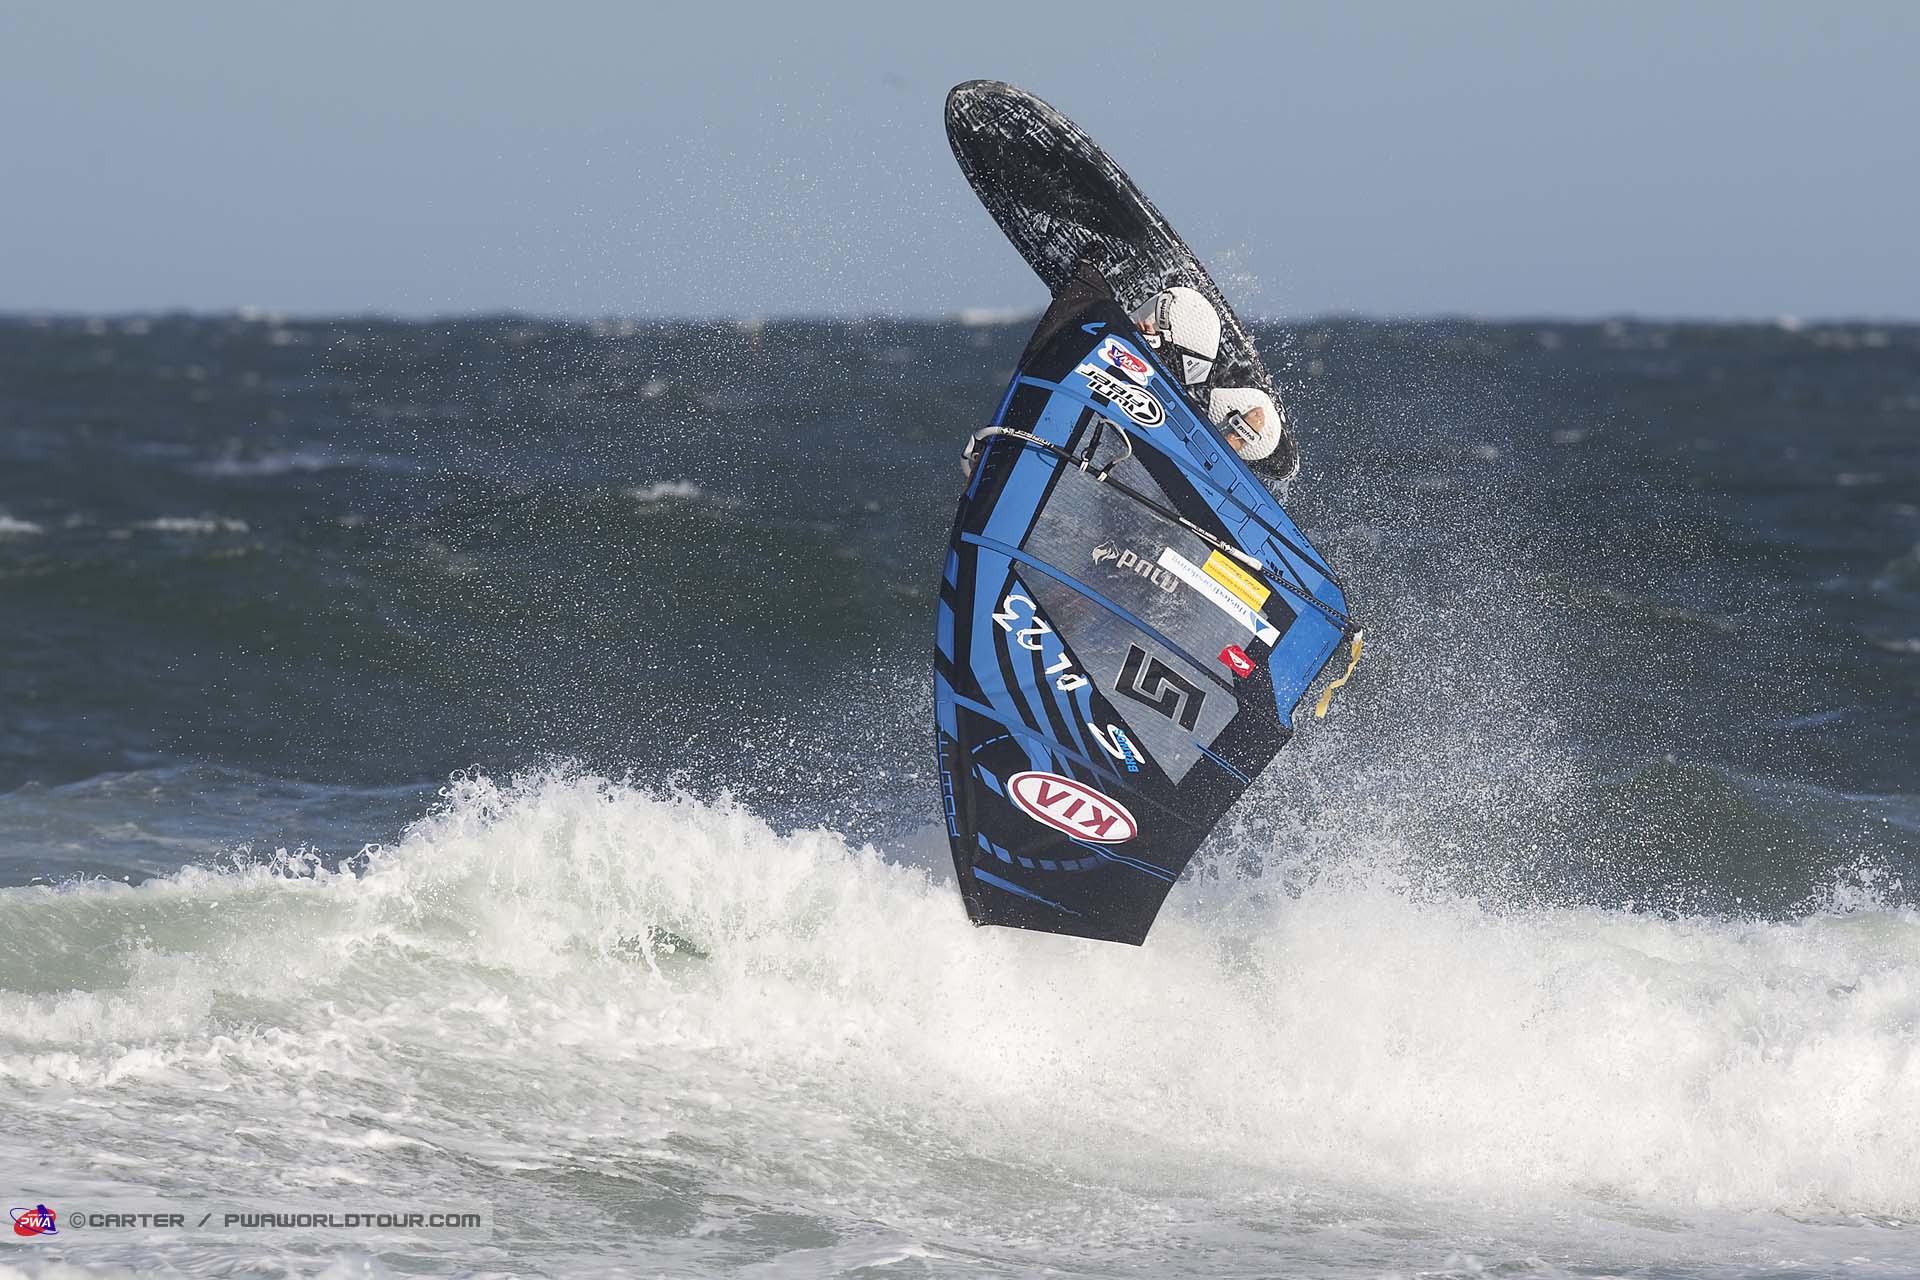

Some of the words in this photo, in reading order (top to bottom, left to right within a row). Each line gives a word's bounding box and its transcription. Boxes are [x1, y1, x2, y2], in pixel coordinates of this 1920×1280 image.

[1112, 347, 1143, 373] PWA
[991, 594, 1053, 651] 23
[1044, 652, 1089, 693] PL
[1114, 727, 1141, 773] BRANDS
[1034, 780, 1119, 838] KIA
